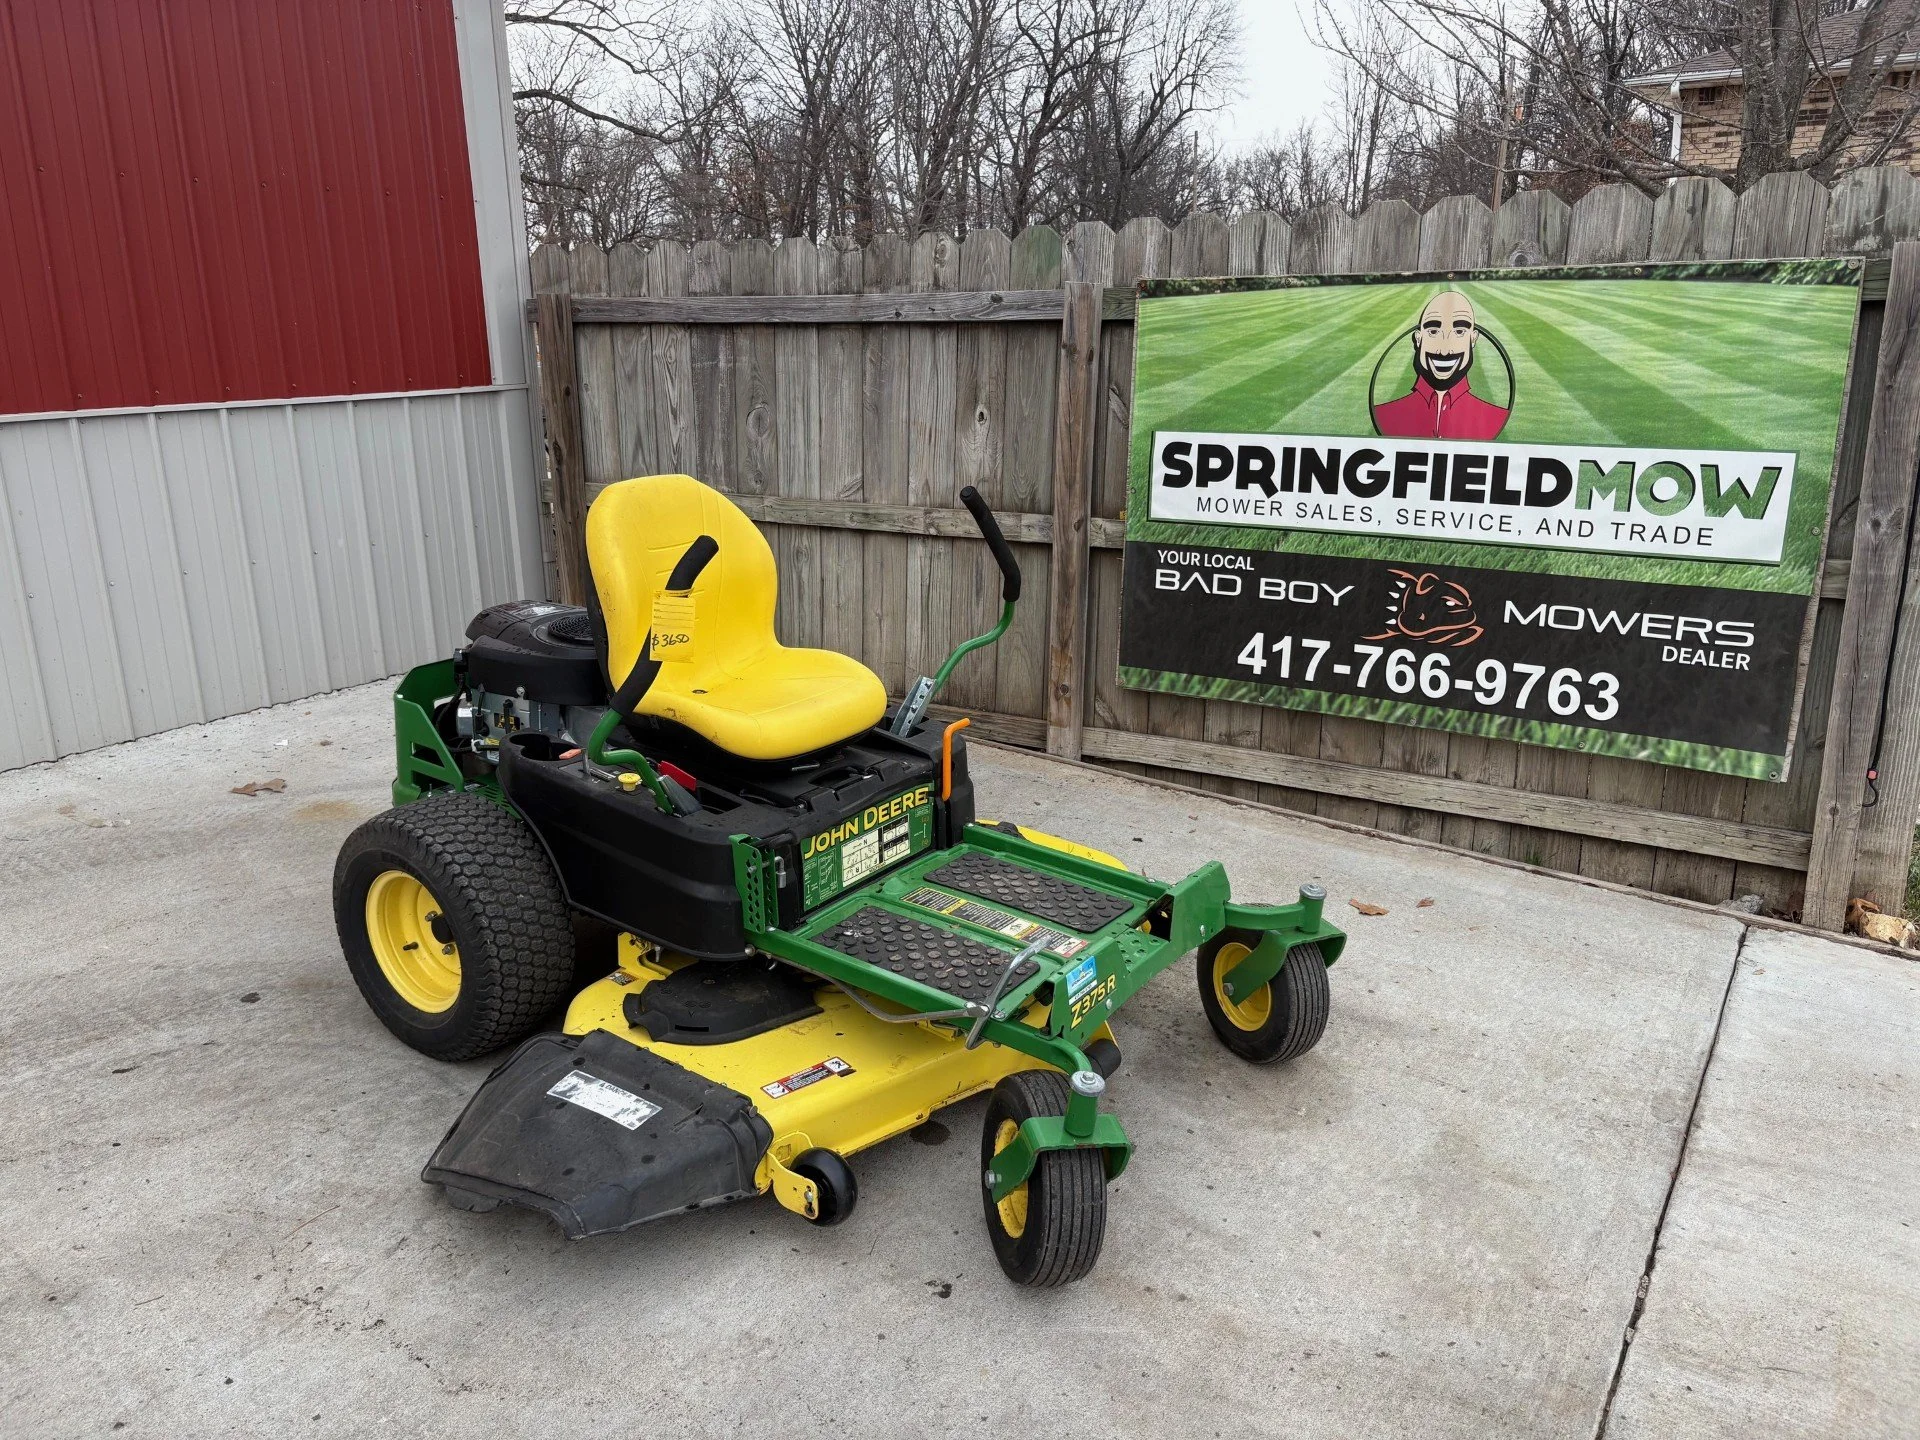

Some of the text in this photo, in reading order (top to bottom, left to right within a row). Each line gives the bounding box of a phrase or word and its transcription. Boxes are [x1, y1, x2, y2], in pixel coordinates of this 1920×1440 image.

[1197, 496, 1714, 545] MOWER SALES, SERVICE, AND TRADE
[1157, 550, 1255, 570] YOUR LOCAL
[1156, 568, 1755, 647] BAD BOY MOWERS
[1237, 633, 1620, 720] 417-766-9763
[1662, 646, 1752, 670] DEALER
[804, 817, 859, 859] JOHN
[864, 787, 929, 830] DEERE
